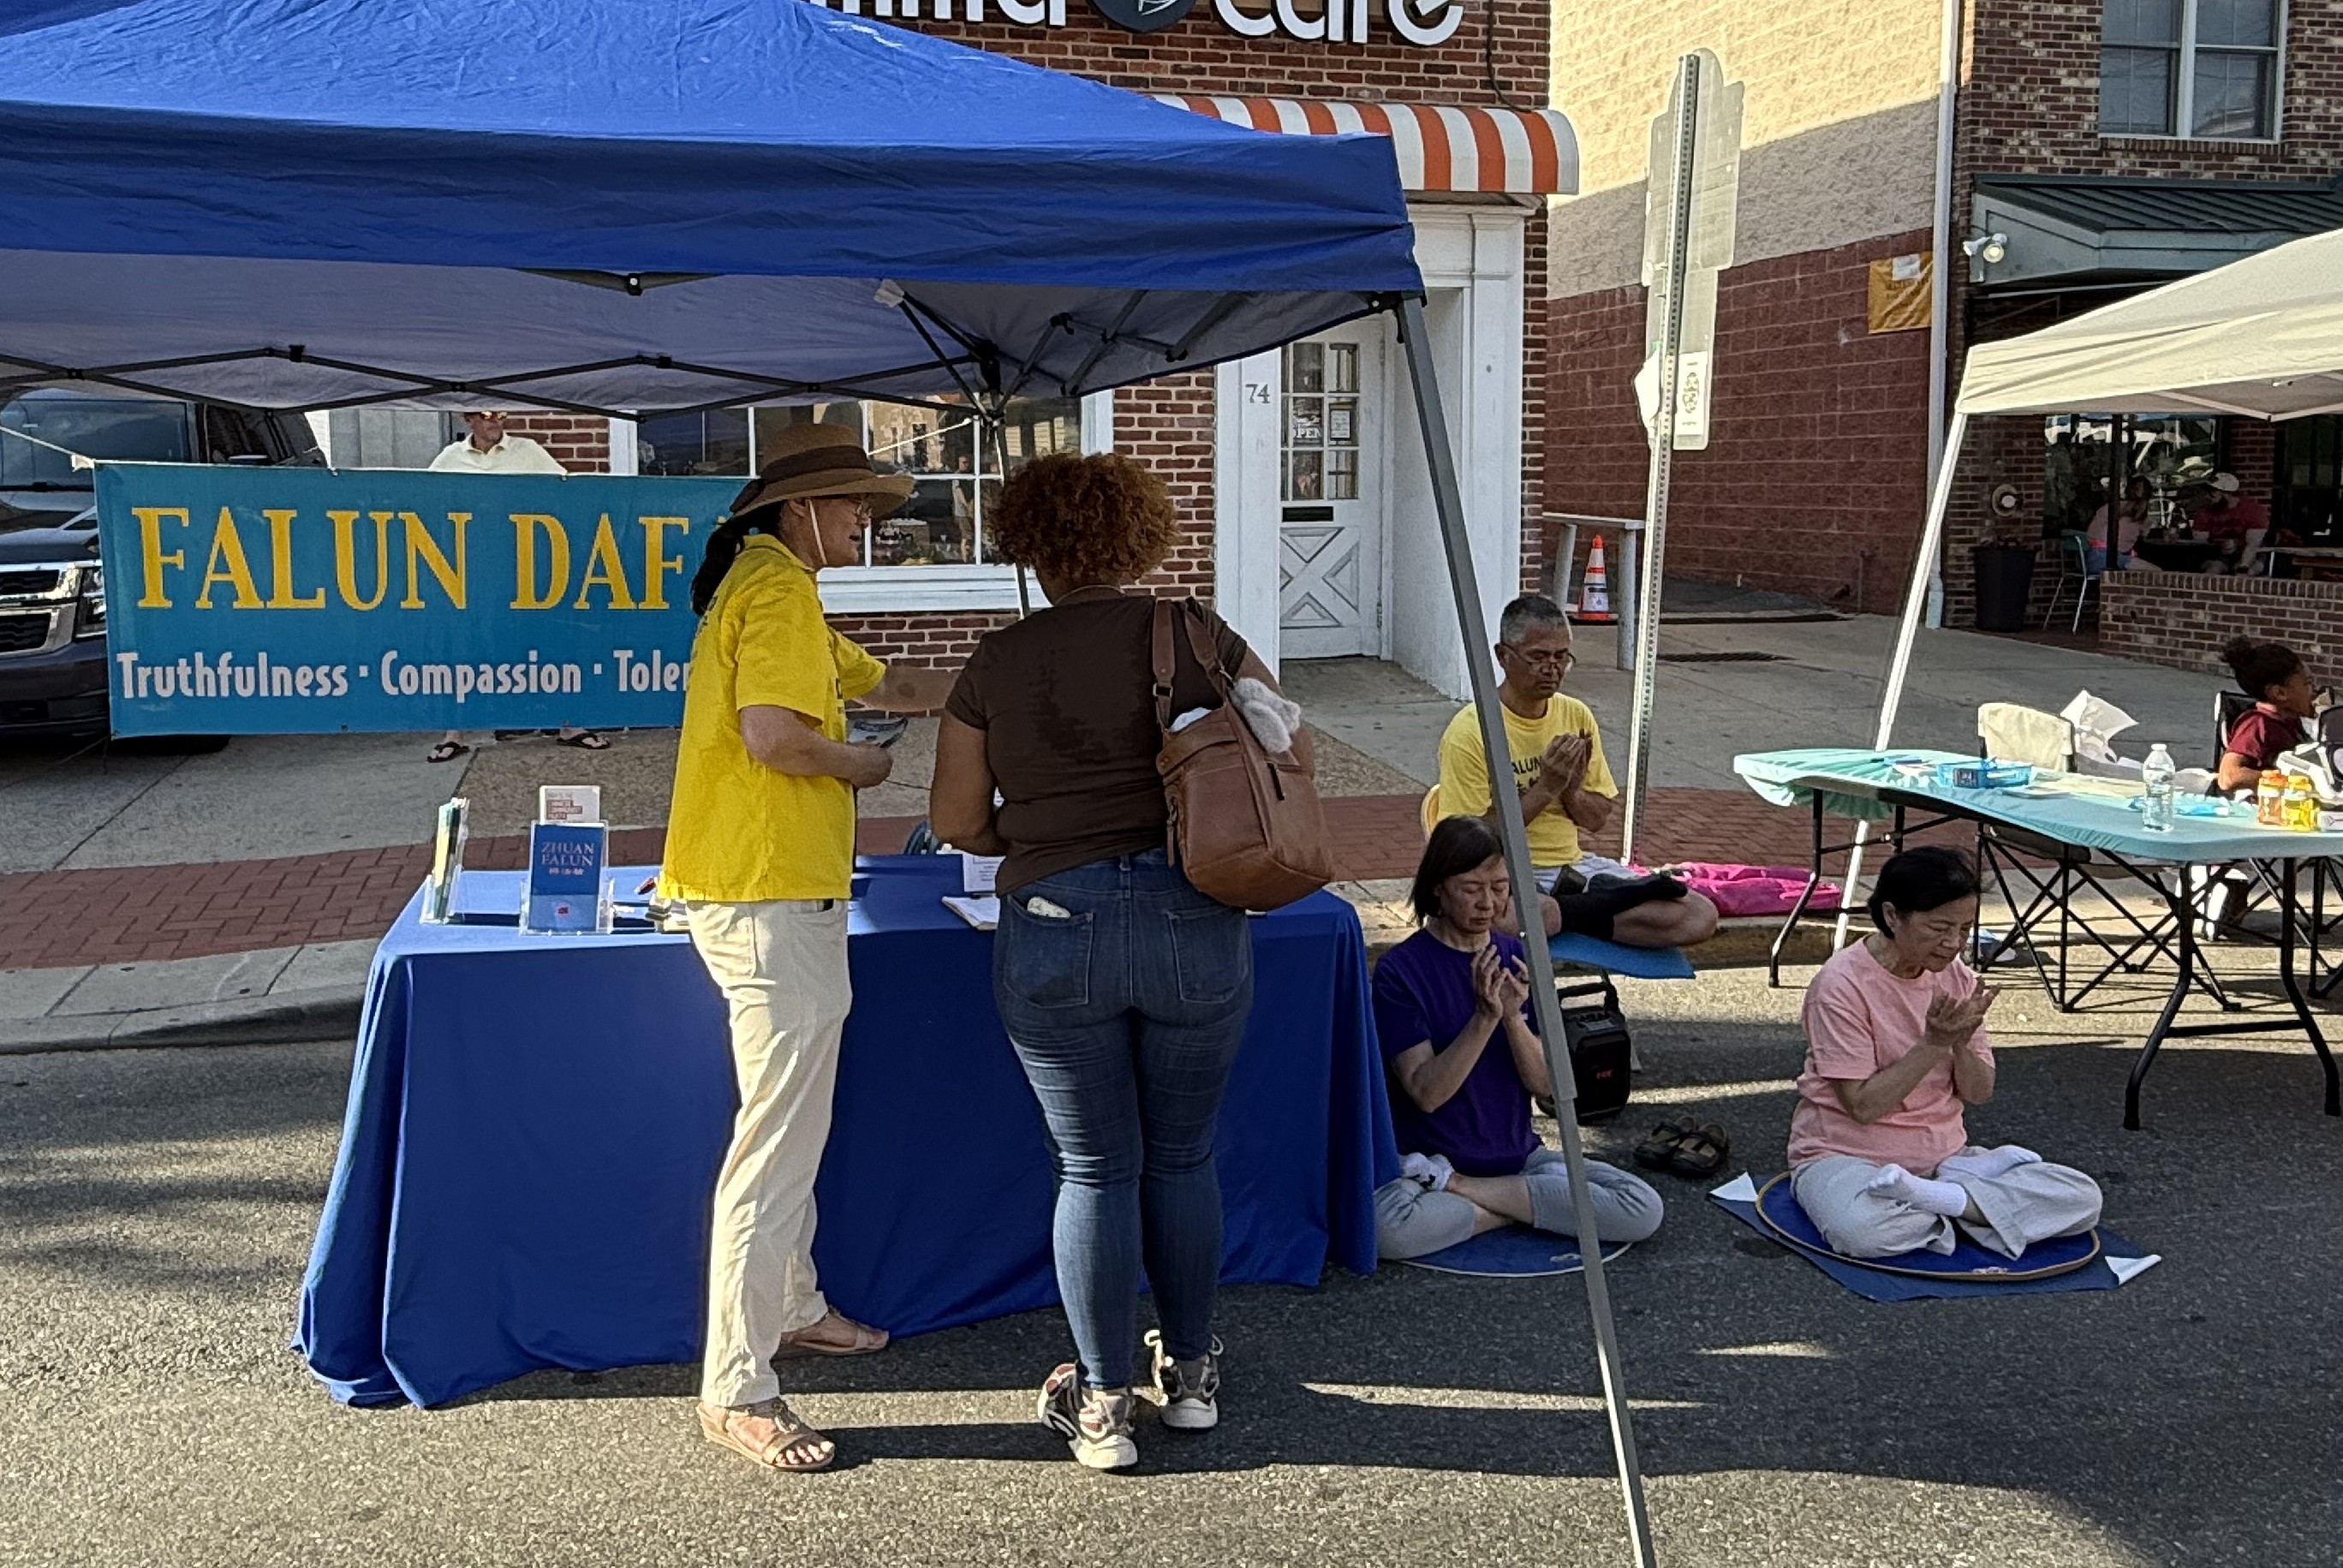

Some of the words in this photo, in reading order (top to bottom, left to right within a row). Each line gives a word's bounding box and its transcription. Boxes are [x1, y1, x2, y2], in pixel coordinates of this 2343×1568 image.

[1245, 383, 1271, 403] 74
[131, 505, 474, 611] FALUN
[508, 512, 728, 611] DAF
[117, 652, 349, 698] Truthfulness
[380, 649, 582, 702] Compassion
[612, 649, 690, 695] Toler
[1511, 755, 1542, 775] ALUN
[541, 842, 594, 854] ZHUAN
[541, 854, 593, 867] FALUN
